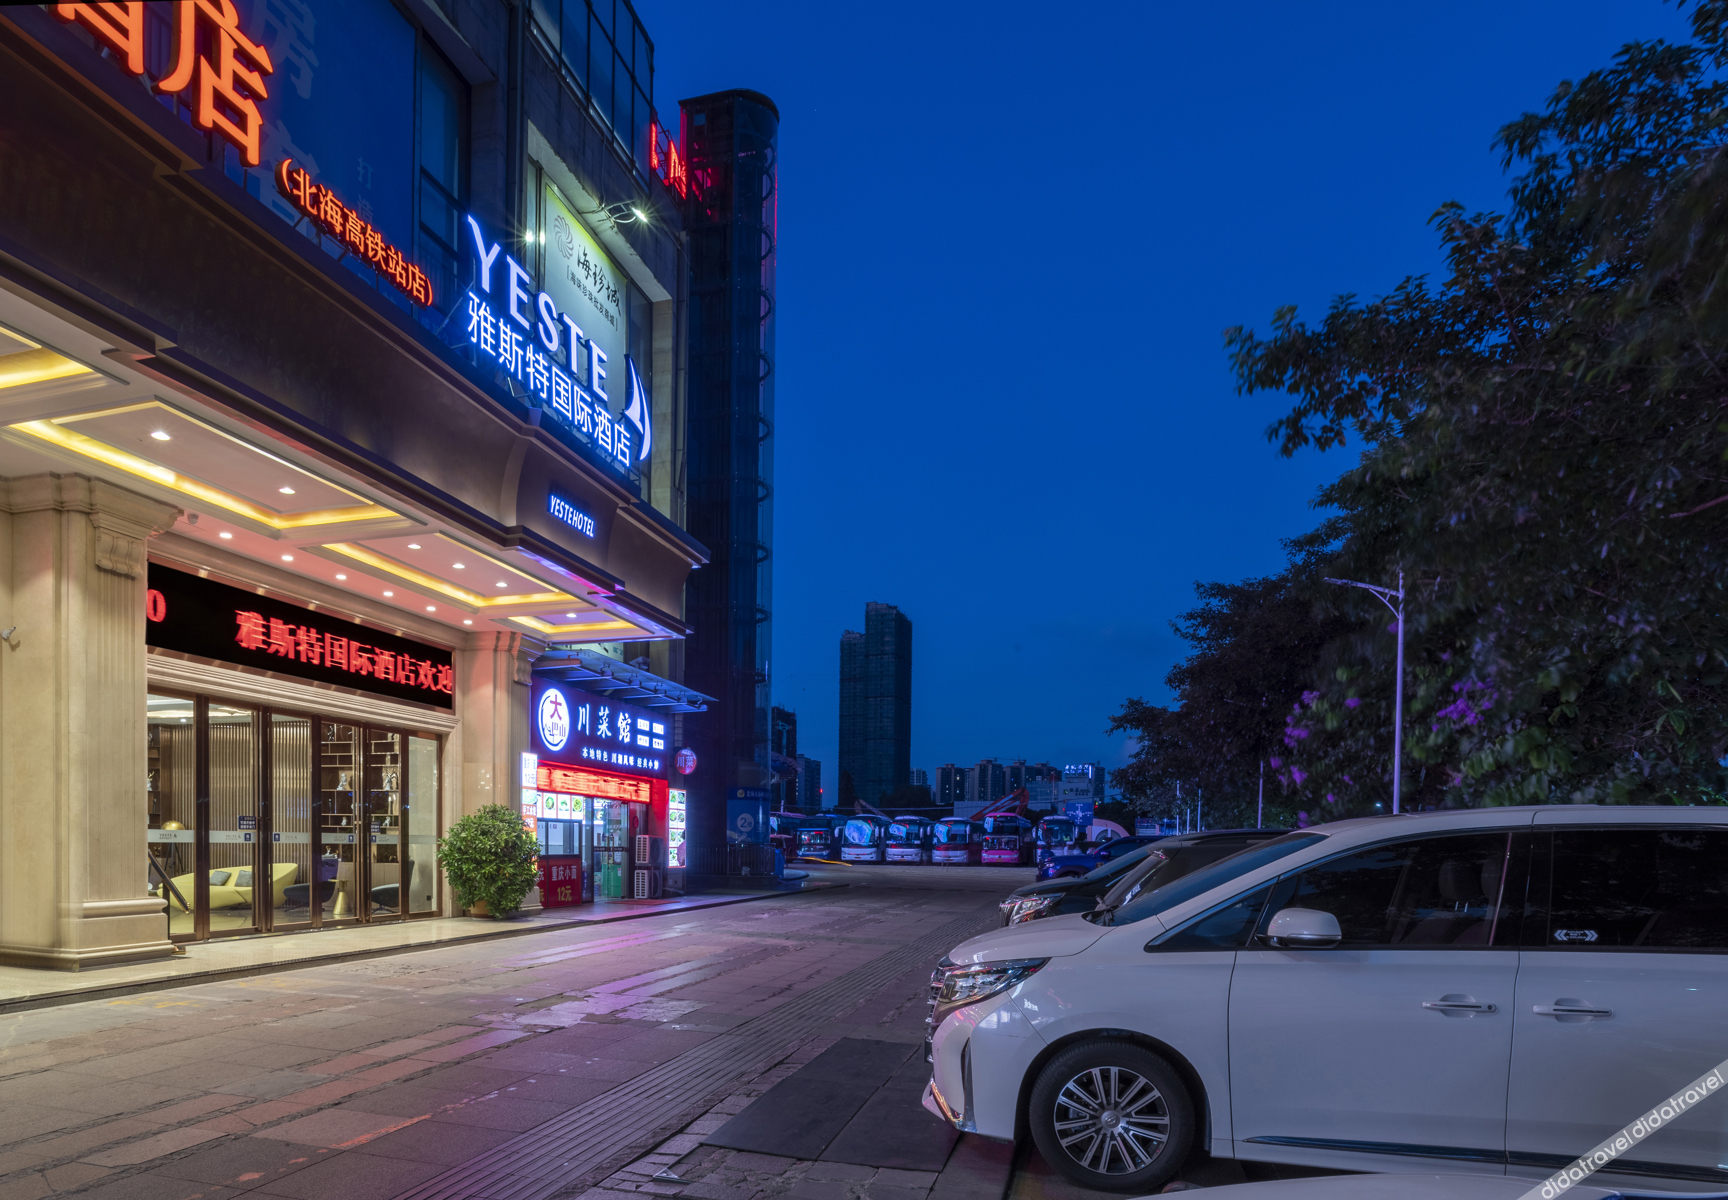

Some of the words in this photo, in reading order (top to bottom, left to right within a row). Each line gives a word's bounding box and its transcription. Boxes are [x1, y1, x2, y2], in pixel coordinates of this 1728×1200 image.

[467, 214, 608, 402] YESTE
[468, 291, 631, 467] 雅斯特国际酒店
[550, 495, 594, 537] YESTEHOTEL
[676, 755, 694, 768] 川菜
[551, 865, 577, 881] 重庆小面
[557, 886, 573, 901] 12元
